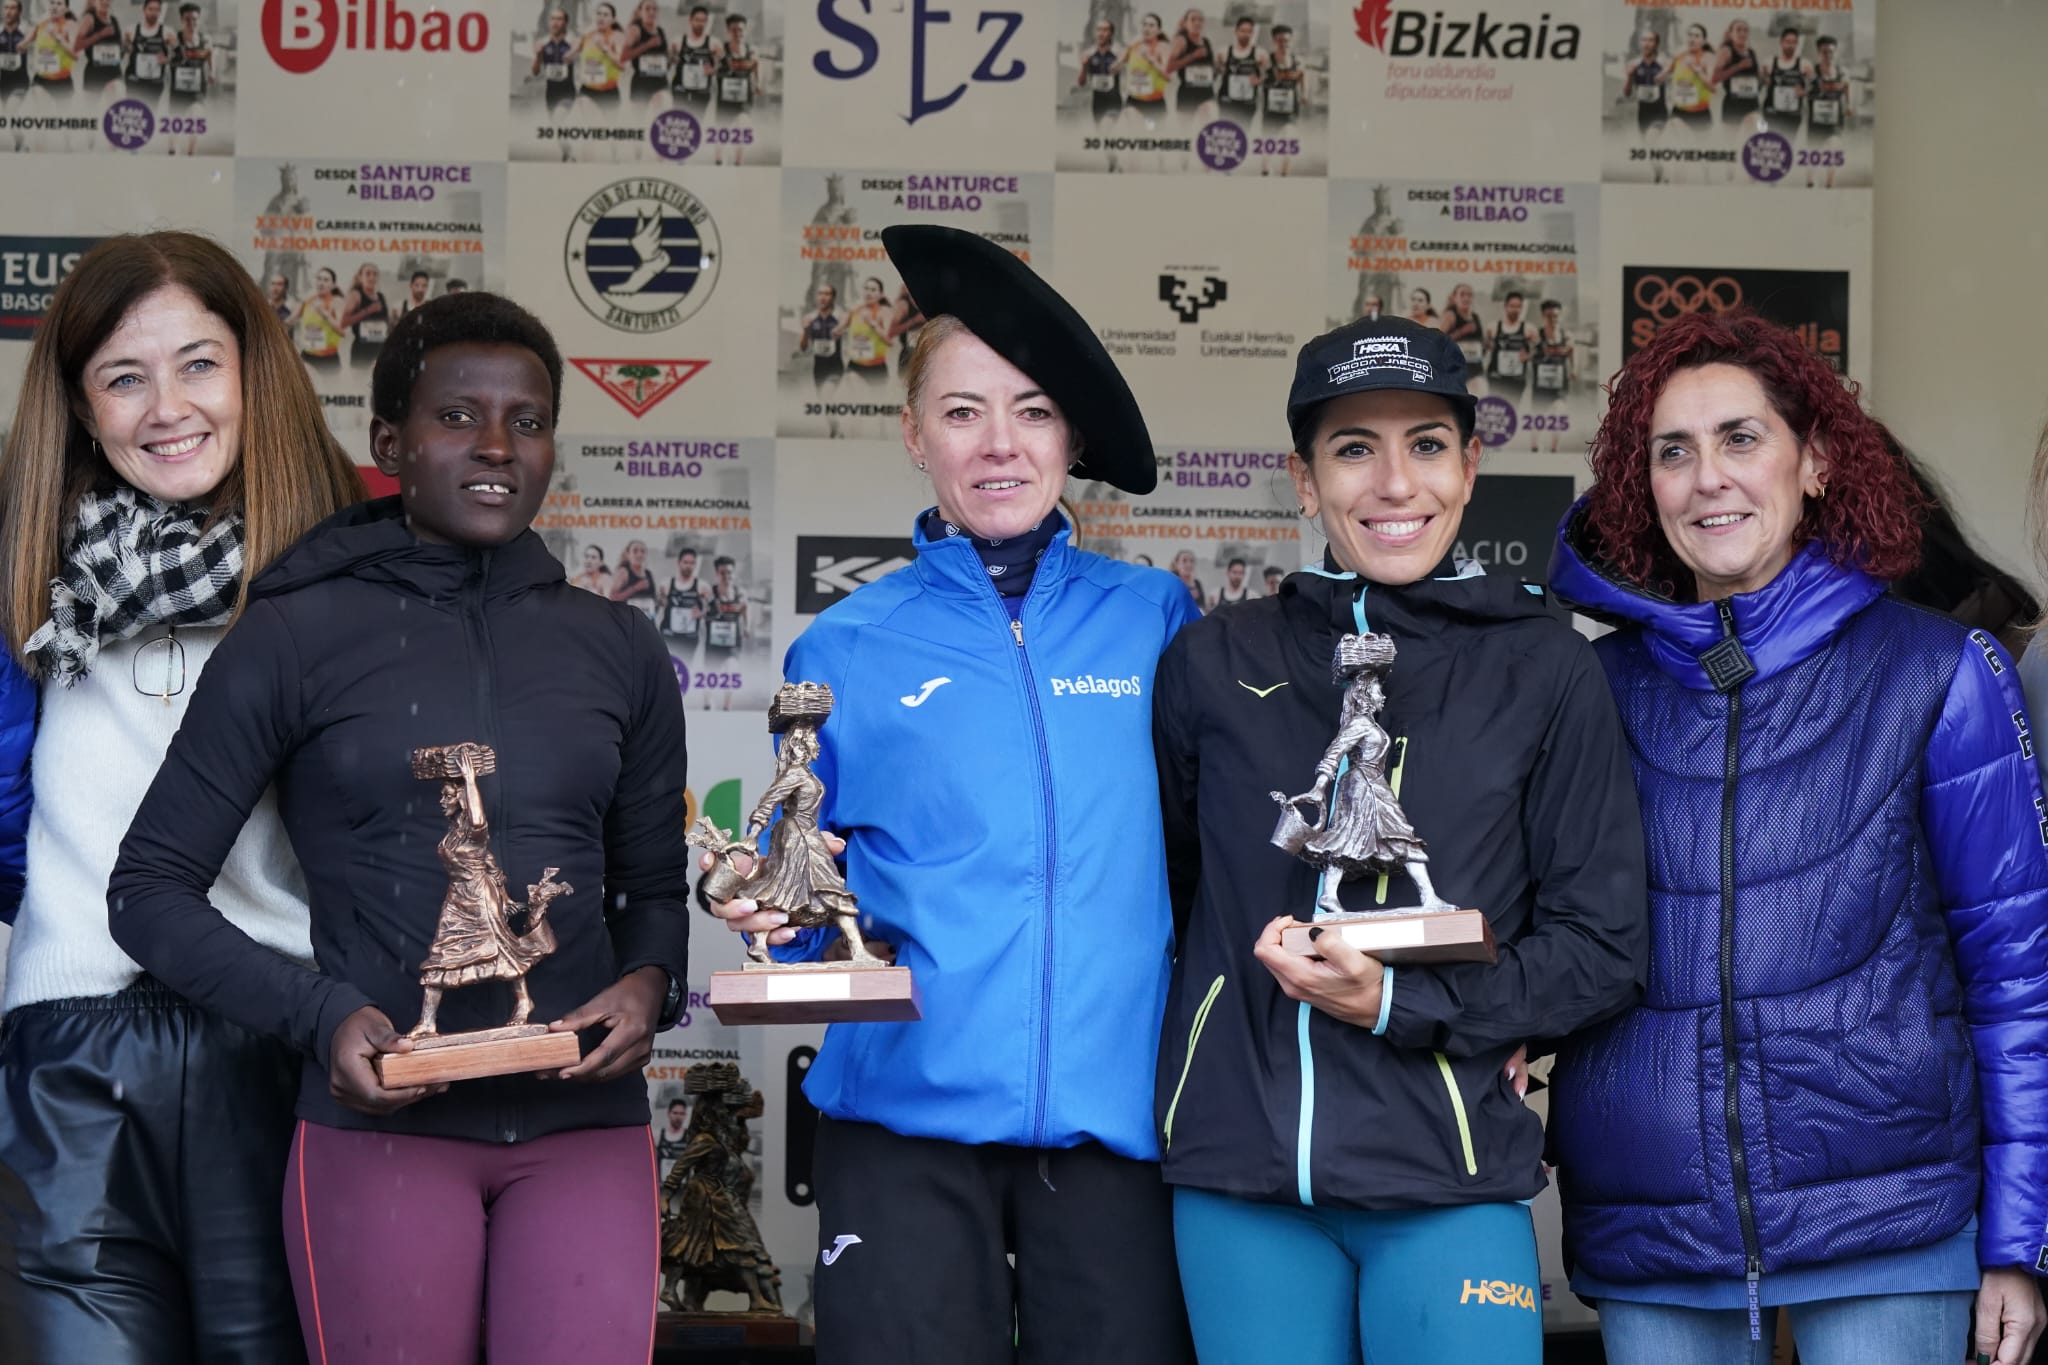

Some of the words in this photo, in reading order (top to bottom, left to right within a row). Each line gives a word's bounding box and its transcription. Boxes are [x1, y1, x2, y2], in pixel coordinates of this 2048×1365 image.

[280, 0, 490, 53] Bilbao
[1390, 10, 1581, 60] Bizkaia
[10, 117, 98, 130] NOVIEMBRE
[159, 118, 207, 134] 2025
[537, 127, 553, 140] 30
[557, 127, 645, 141] NOVIEMBRE
[706, 128, 754, 144] 2025
[1085, 138, 1101, 149] 30
[1104, 138, 1190, 151] NOVIEMBRE
[1253, 139, 1300, 155] 2025
[1650, 149, 1736, 162] NOVIEMBRE
[1798, 150, 1845, 167] 2025
[315, 169, 357, 180] DESDE
[360, 164, 471, 183] SANTURCE
[347, 184, 357, 195] A
[360, 184, 435, 201] BILBAO
[861, 179, 904, 191] DESDE
[907, 175, 1019, 193] SANTURCE
[894, 195, 904, 206] A
[907, 195, 982, 212] BILBAO
[1408, 190, 1450, 201] DESDE
[1453, 186, 1564, 204] SANTURCE
[1440, 205, 1450, 216] A
[1453, 205, 1528, 222] BILBAO
[316, 220, 376, 231] CARRERA
[379, 221, 484, 234] INTERNACIONAL
[253, 236, 376, 252] NAZIOARTEKO
[379, 239, 484, 254] LASTERKETA
[1409, 240, 1470, 252] CARRERA
[1472, 242, 1577, 254] INTERNACIONAL
[800, 247, 888, 262] NAZIOART
[1348, 257, 1469, 273] NAZIOARTEKO
[1473, 259, 1577, 274] LASTERKETA
[1359, 343, 1401, 355] HOKA
[805, 403, 822, 415] 30
[825, 403, 903, 417] NOVIEMBR
[1522, 415, 1570, 431] 2025
[582, 446, 625, 457] DESDE
[627, 441, 740, 459] SANTURCE
[1176, 451, 1288, 470] SANTURCE
[614, 461, 625, 472] A
[627, 461, 703, 478] BILBAO
[1163, 471, 1173, 482] A
[1176, 471, 1251, 488] BILBAO
[583, 497, 643, 509] CARRERA
[646, 498, 752, 511] INTERNACIONAL
[1132, 507, 1192, 519] CARRERA
[534, 514, 643, 529] AZIOARTEKO
[646, 515, 753, 531] LASTERKETA
[1195, 525, 1301, 541] LASTERKETA
[695, 672, 742, 689] 2025
[1460, 1279, 1537, 1313] HOKA
